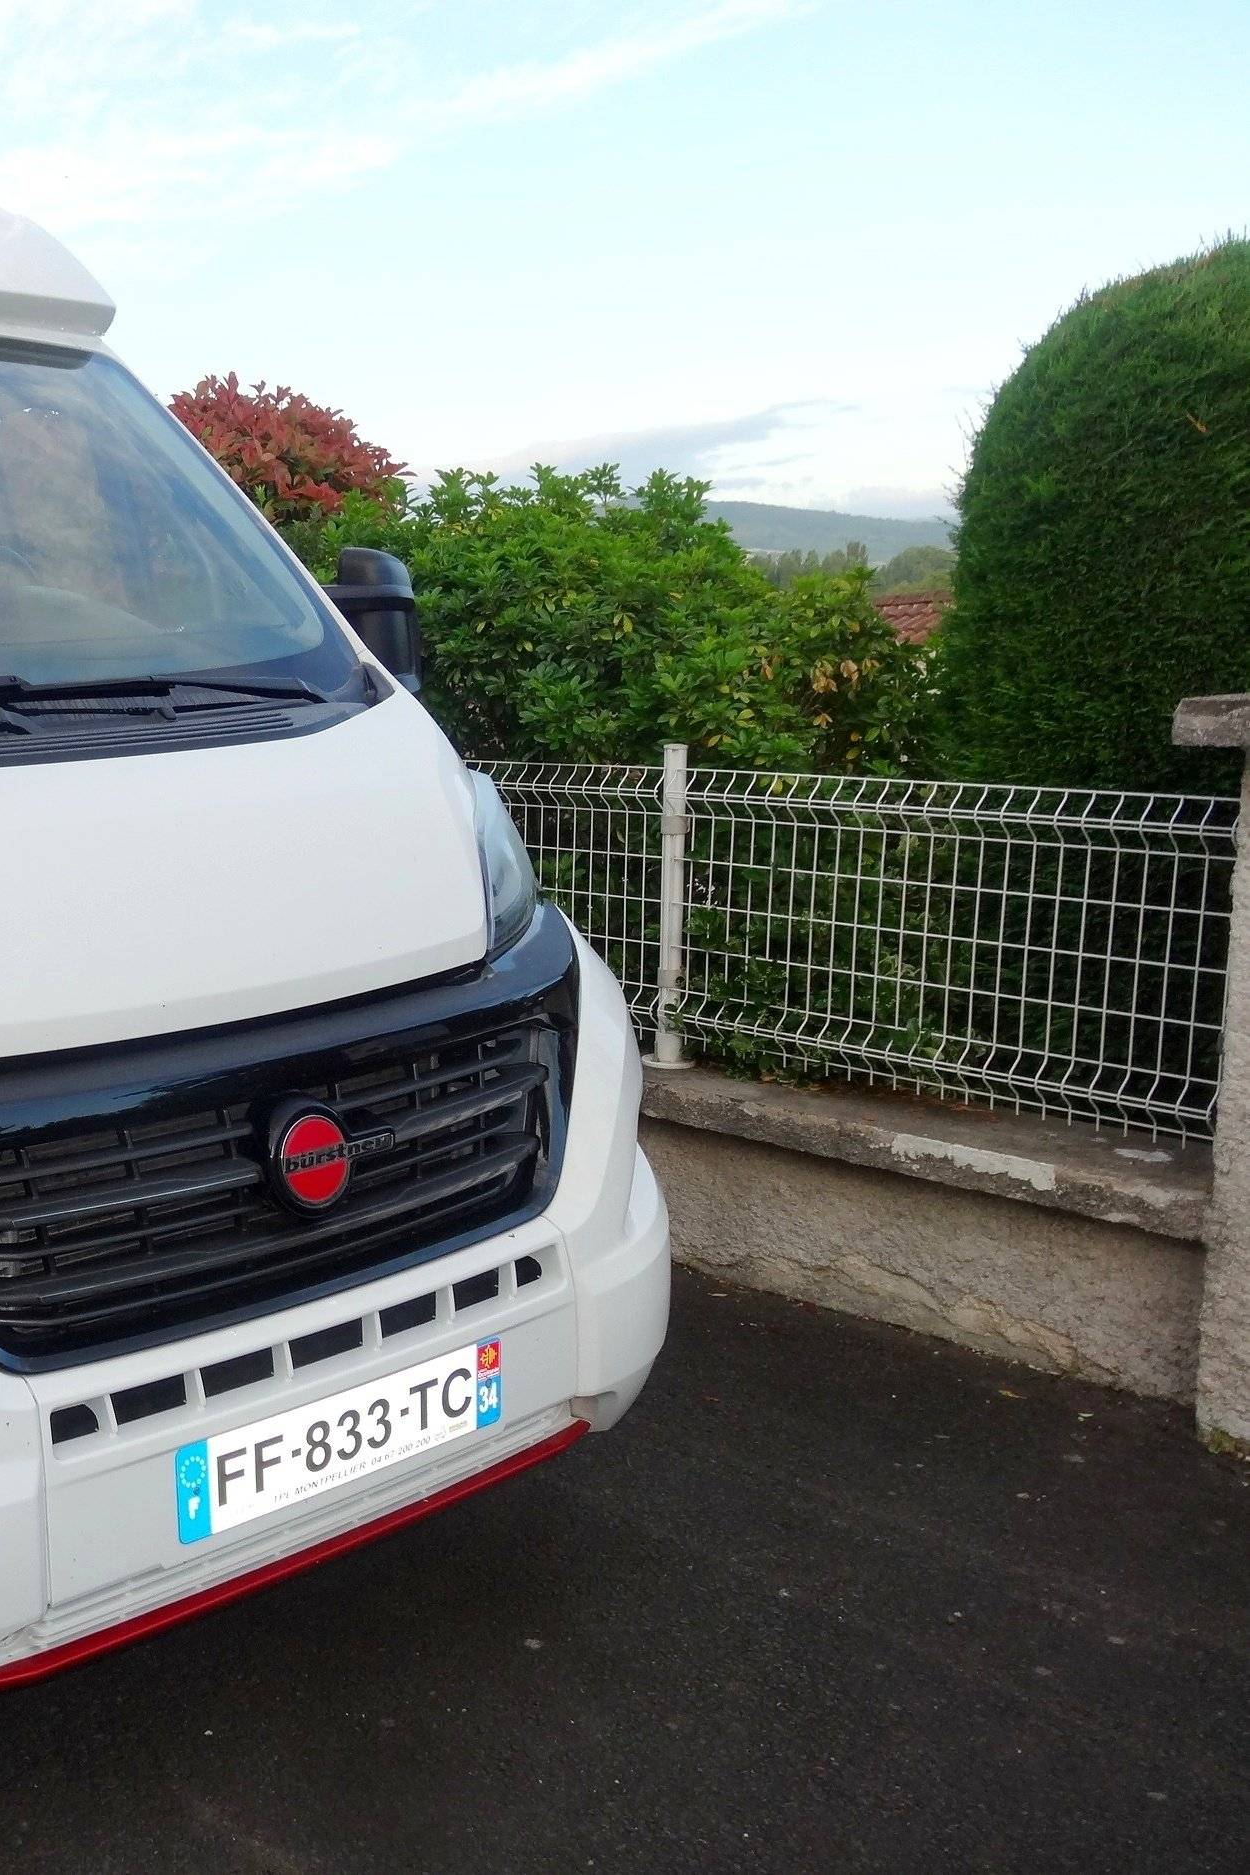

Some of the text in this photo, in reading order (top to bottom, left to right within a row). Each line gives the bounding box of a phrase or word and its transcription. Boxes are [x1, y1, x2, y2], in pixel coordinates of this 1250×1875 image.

[479, 1381, 498, 1413] 34
[216, 1367, 472, 1507] FF-833-TC
[188, 1496, 201, 1520] F
